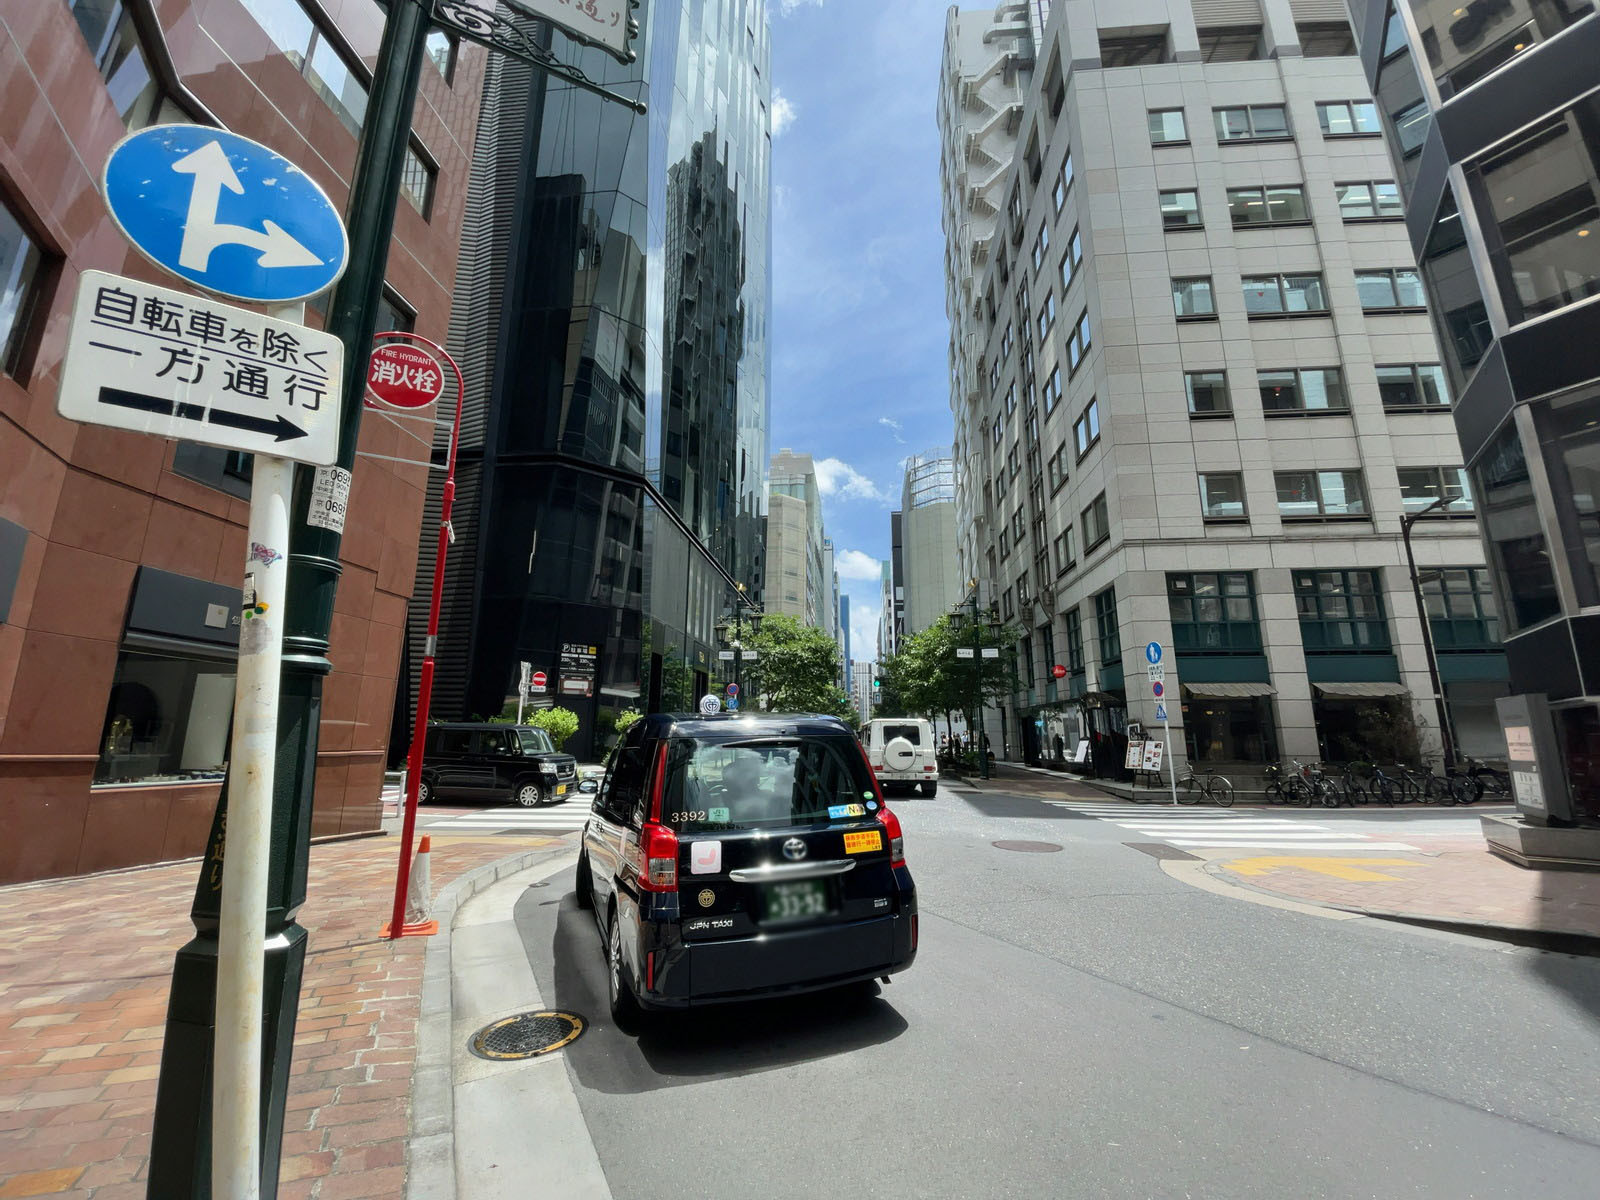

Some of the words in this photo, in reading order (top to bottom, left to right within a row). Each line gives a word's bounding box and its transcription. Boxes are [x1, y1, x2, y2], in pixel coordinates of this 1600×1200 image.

[95, 287, 328, 373] 自転車を除く
[381, 349, 397, 358] FIRE
[400, 353, 432, 365] HYDRANT
[89, 341, 328, 411] 一方通行
[371, 358, 438, 393] 消火栓
[671, 810, 706, 823] 3392
[690, 922, 709, 930] JPN
[711, 920, 733, 928] TAXI
